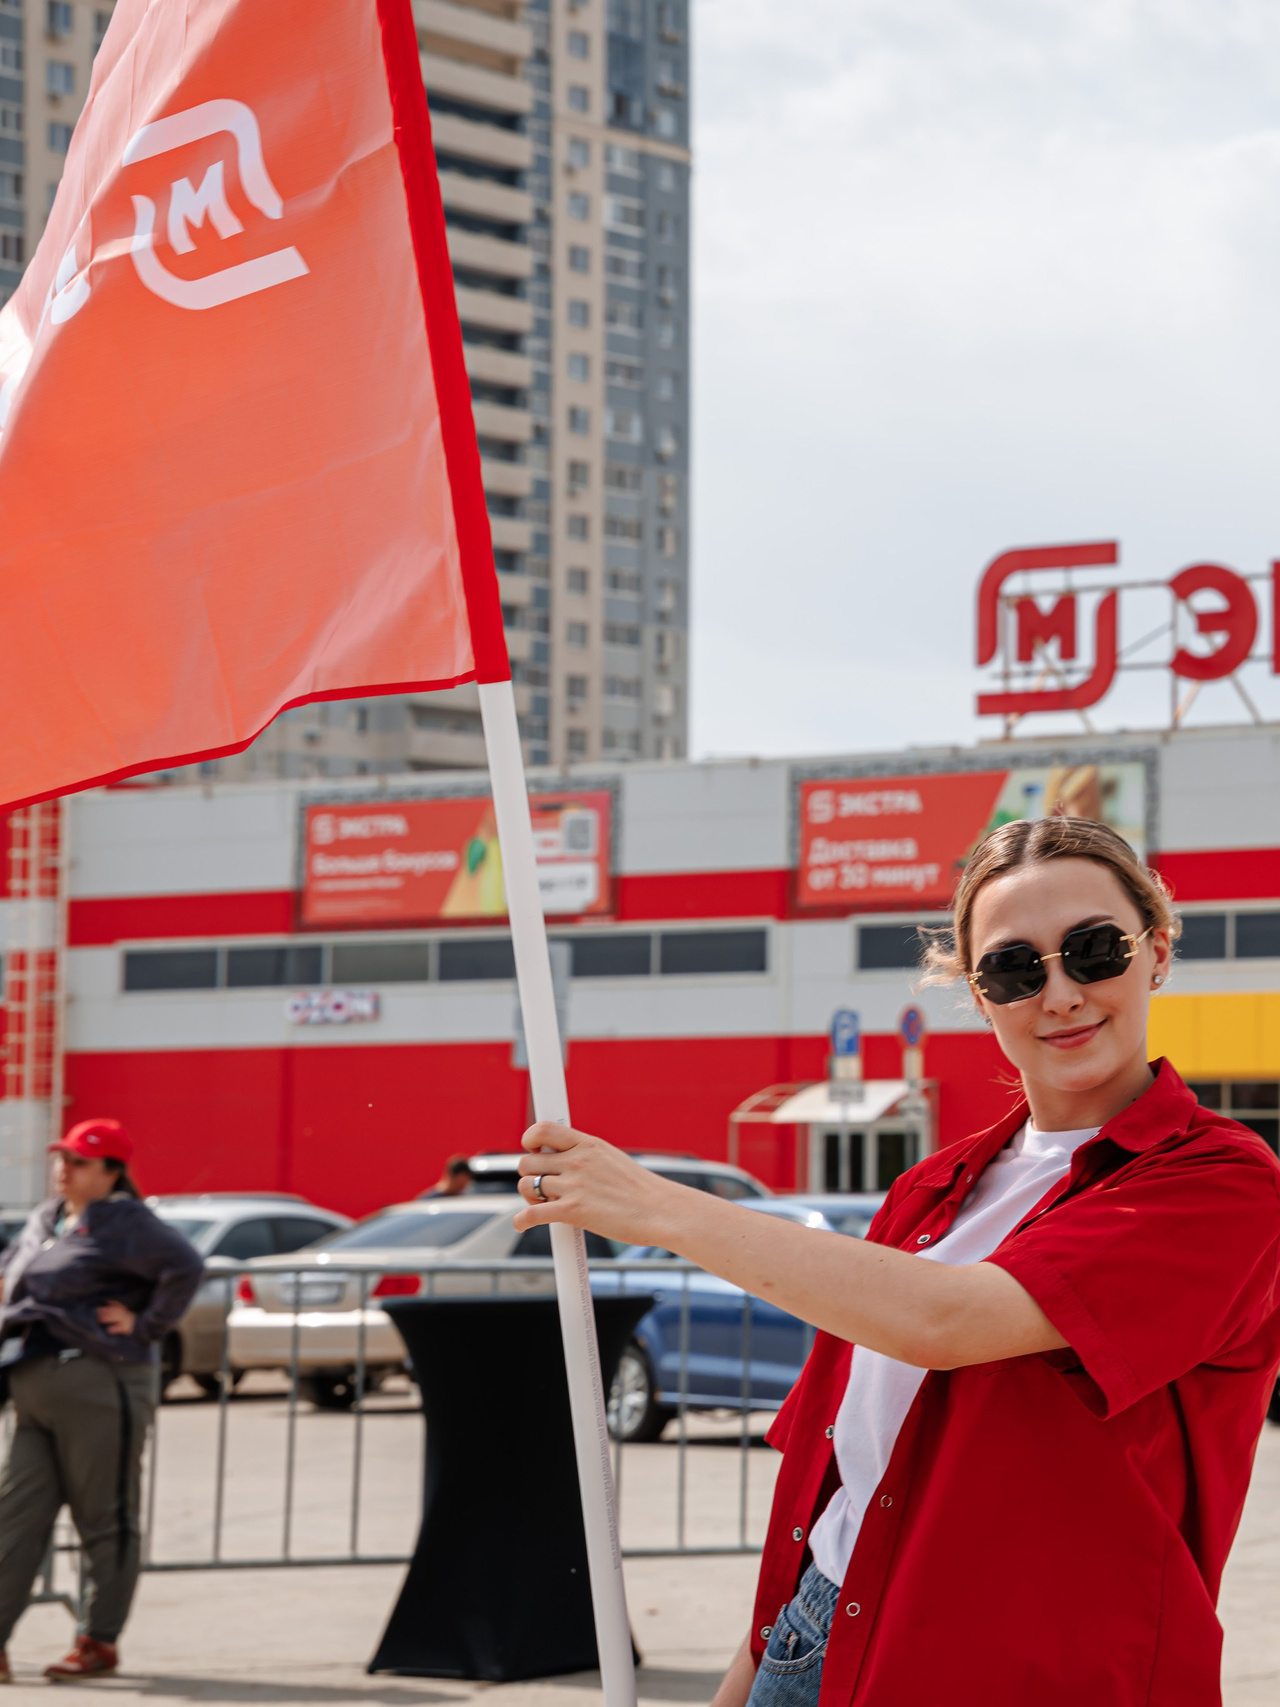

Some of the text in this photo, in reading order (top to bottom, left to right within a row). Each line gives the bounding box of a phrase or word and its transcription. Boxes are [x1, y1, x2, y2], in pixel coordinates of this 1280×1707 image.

[838, 790, 922, 817] ЭКСТРА
[808, 837, 917, 866] Доставка
[808, 866, 834, 890] от
